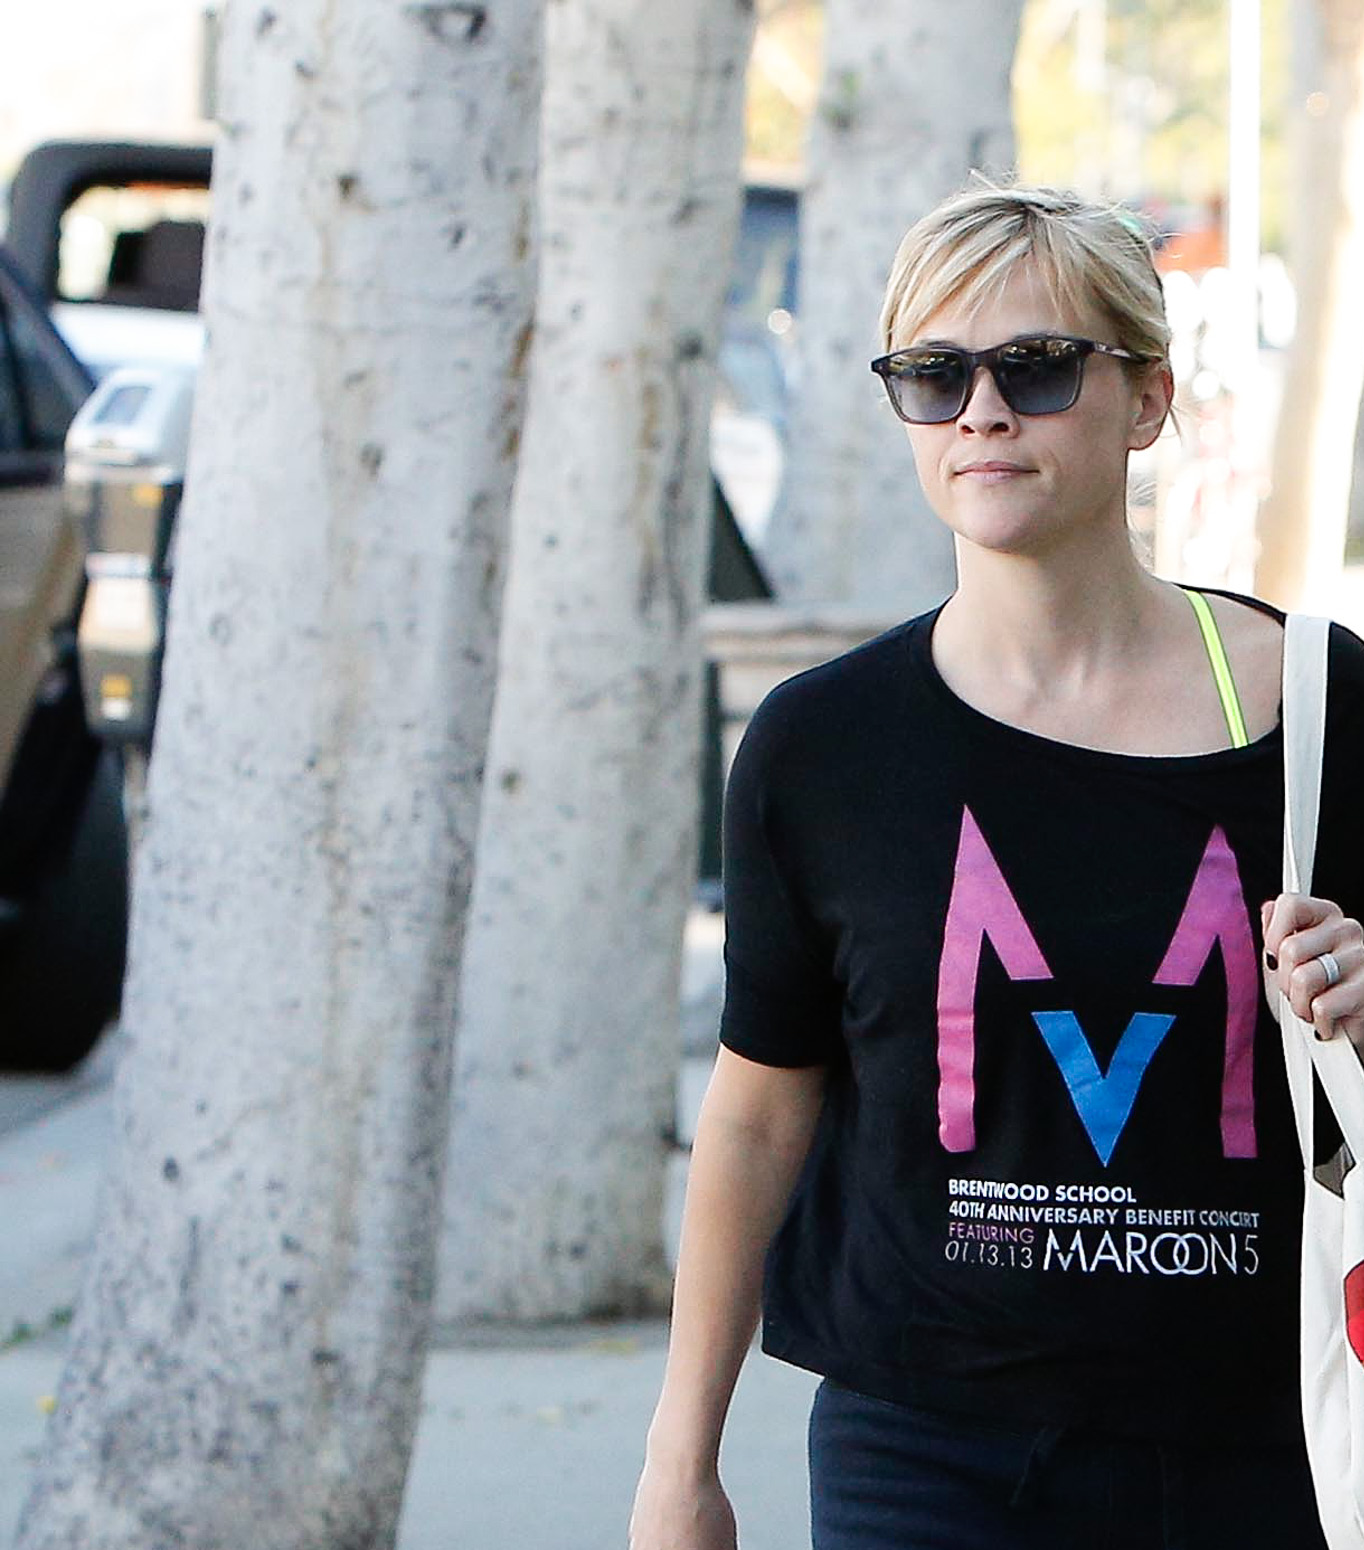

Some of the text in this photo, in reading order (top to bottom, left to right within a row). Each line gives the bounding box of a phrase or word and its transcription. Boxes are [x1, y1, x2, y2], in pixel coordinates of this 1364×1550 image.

[948, 1178, 1137, 1203] BRENTWOOD SCHOOL
[948, 1200, 985, 1219] 40TH
[986, 1203, 1119, 1225] ANNIVERSARY
[1125, 1208, 1196, 1226] BENEFIT
[948, 1222, 1035, 1244] FEATURING
[945, 1240, 1033, 1269] 01.13.13
[1042, 1227, 1260, 1275] MAROON 5
